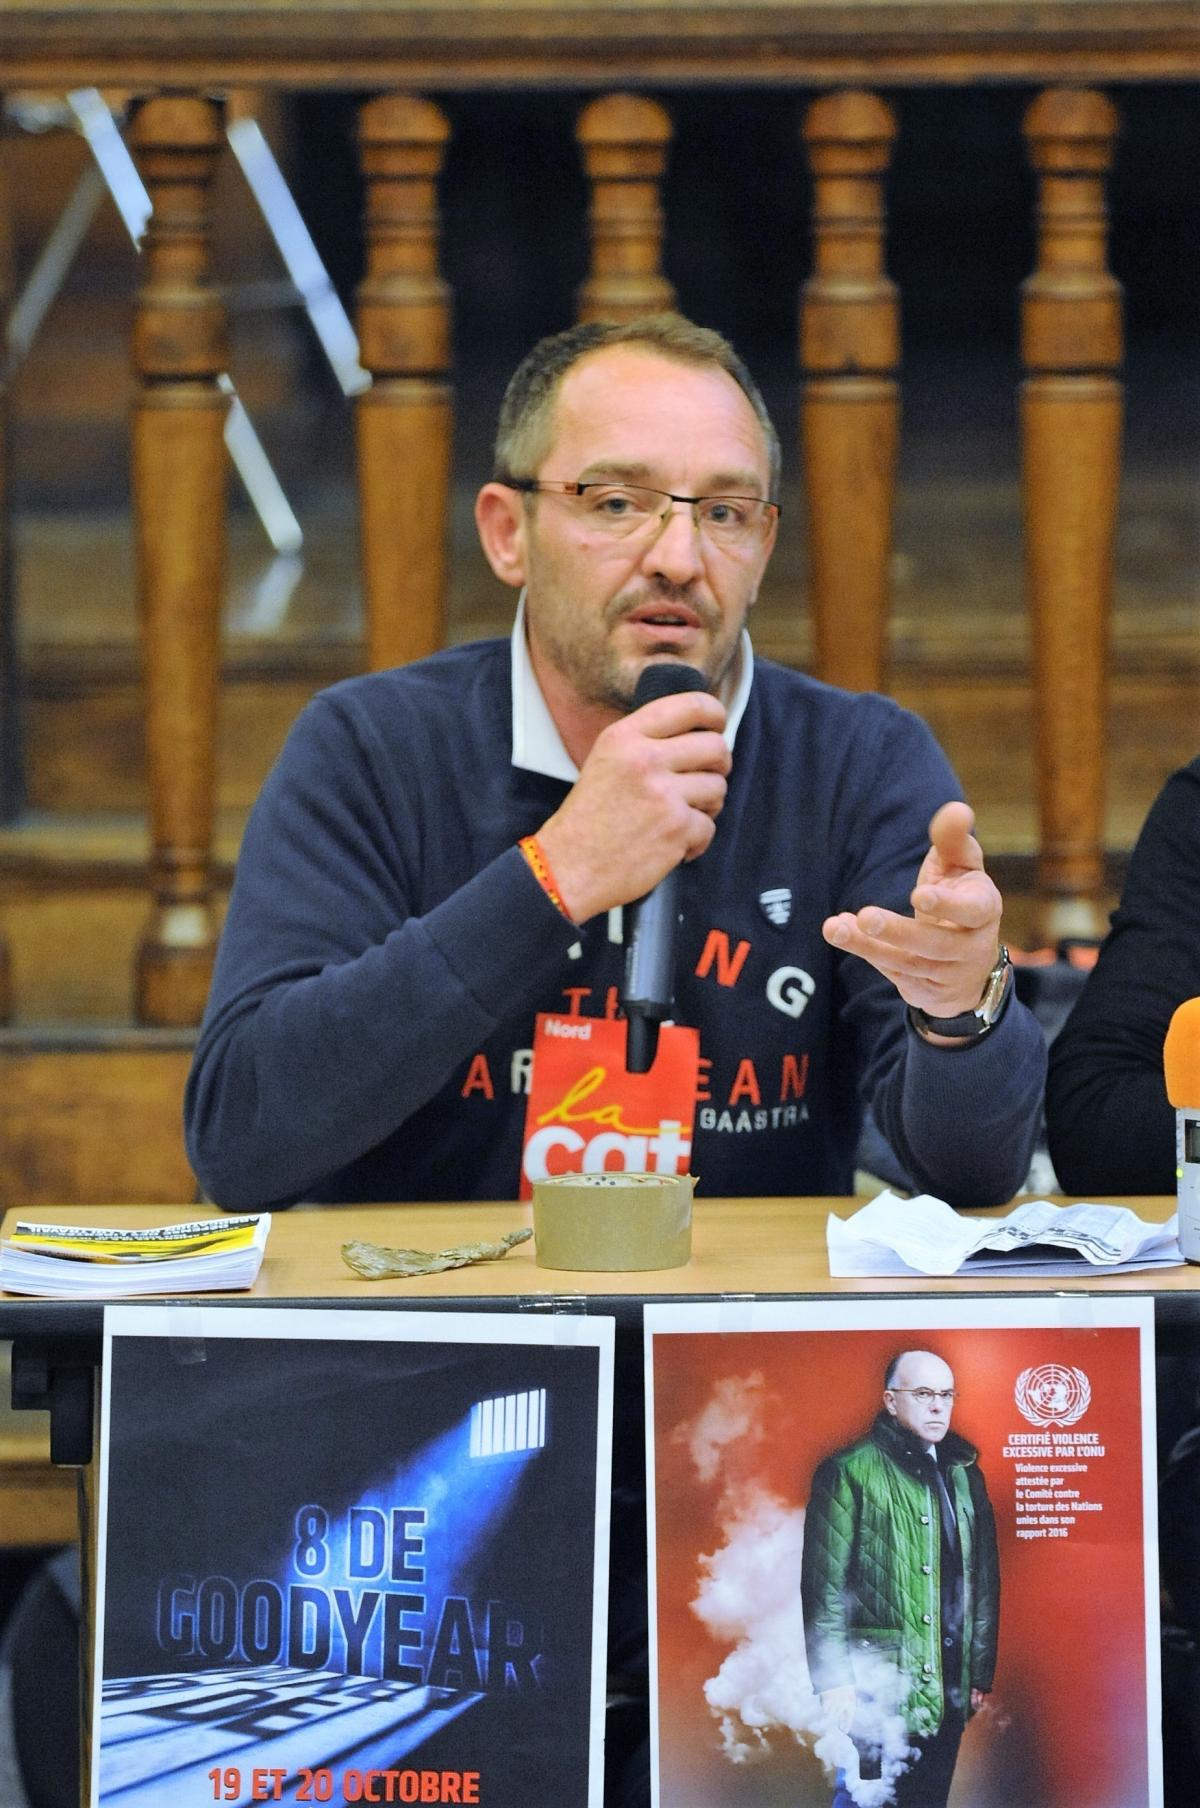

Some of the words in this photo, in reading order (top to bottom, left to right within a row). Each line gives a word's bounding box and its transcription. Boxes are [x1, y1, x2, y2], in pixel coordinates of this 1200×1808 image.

[544, 1019, 592, 1040] Nord
[1008, 1432, 1051, 1445] CERTIFIÉ
[1052, 1433, 1099, 1445] VIOLENCE
[1003, 1446, 1053, 1458] EXCESSIVE
[1055, 1446, 1075, 1457] PAR
[1076, 1446, 1105, 1457] L'ONU
[1015, 1463, 1049, 1473] Violence
[1050, 1463, 1088, 1472] excessive
[1015, 1476, 1049, 1486] attestée
[1050, 1477, 1064, 1487] par
[1016, 1489, 1024, 1498] le
[1025, 1489, 1053, 1499] Comité
[1054, 1490, 1080, 1498] contre
[1016, 1502, 1024, 1511] la
[1025, 1503, 1054, 1511] torture
[1055, 1502, 1070, 1511] des
[1071, 1501, 1103, 1511] Nations
[1016, 1515, 1038, 1525] unies
[1039, 1515, 1059, 1524] dans
[1060, 1516, 1075, 1524] son
[1016, 1529, 1047, 1539] rapport
[1048, 1528, 1068, 1537] 2016
[293, 1503, 331, 1577] 8
[346, 1506, 428, 1583] DE
[155, 1574, 547, 1692] GOODYEAR
[208, 1768, 241, 1801] 19
[252, 1768, 287, 1801] ET
[296, 1769, 333, 1803] 20
[343, 1770, 480, 1804] OCTOBRE
